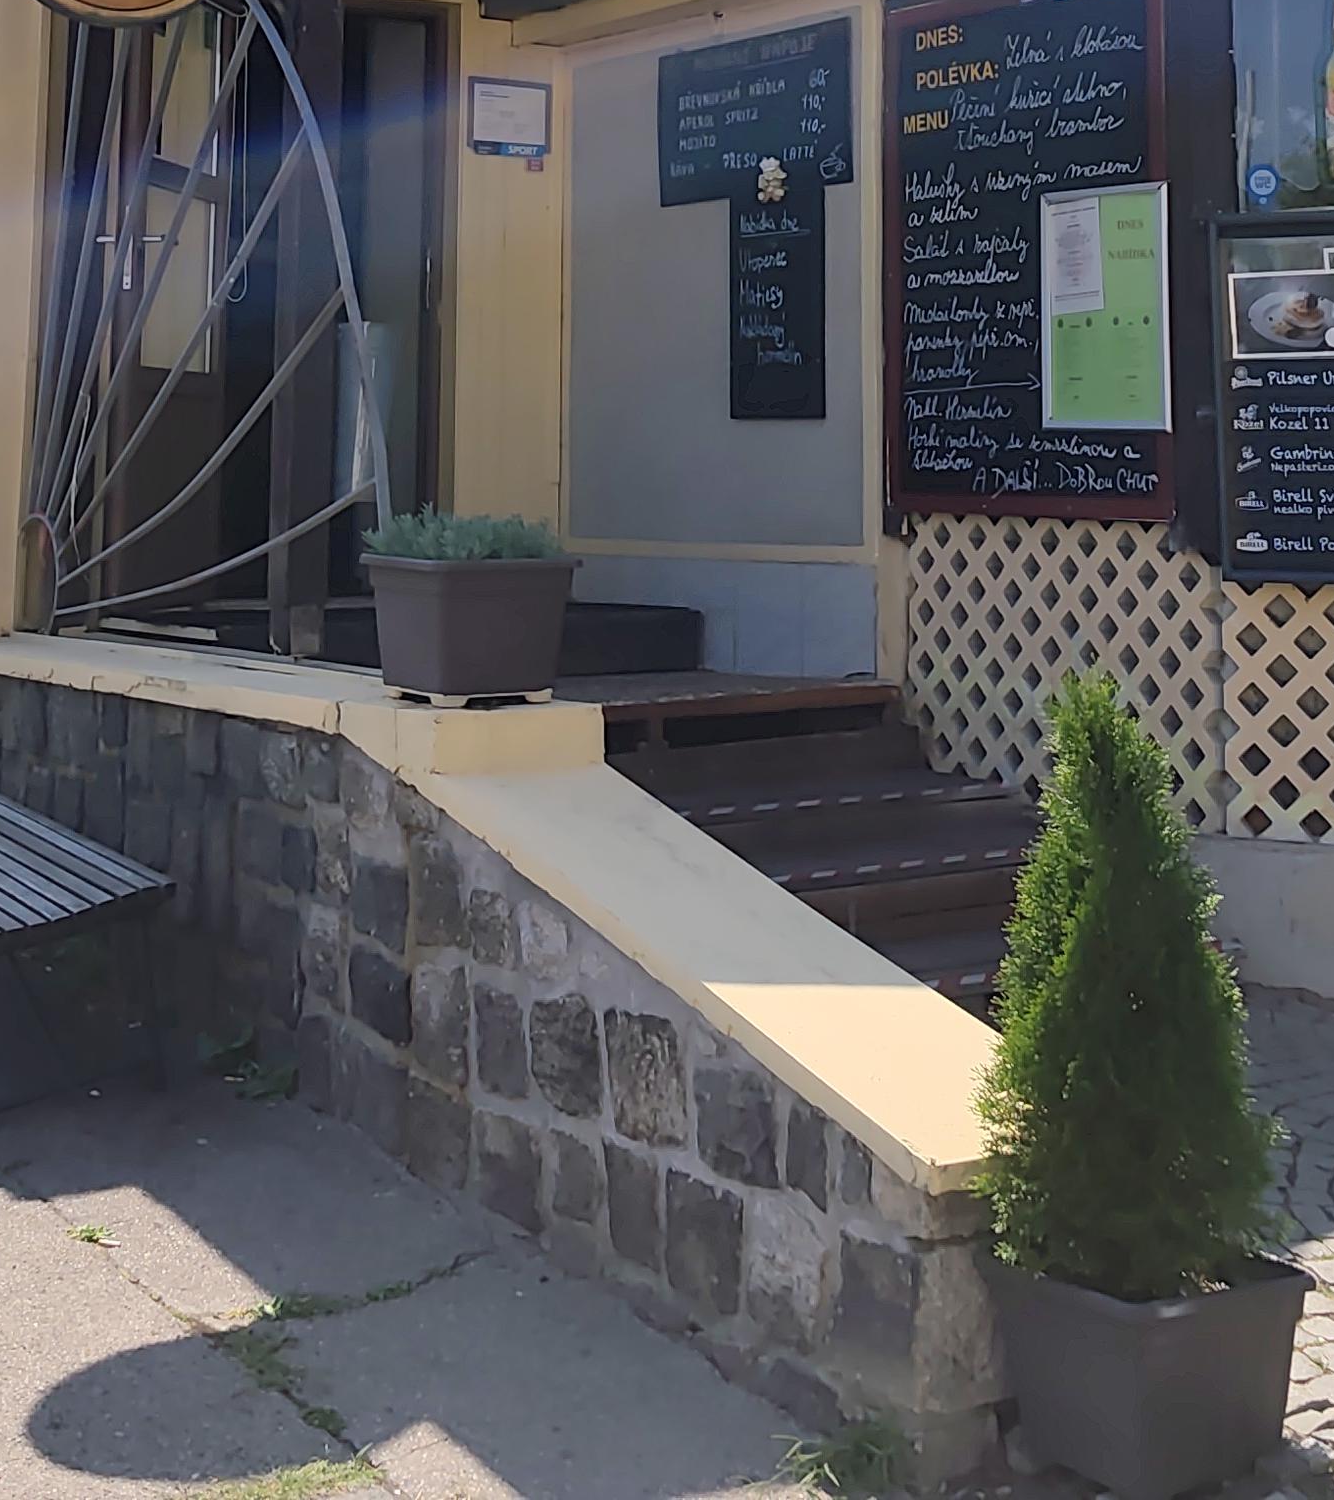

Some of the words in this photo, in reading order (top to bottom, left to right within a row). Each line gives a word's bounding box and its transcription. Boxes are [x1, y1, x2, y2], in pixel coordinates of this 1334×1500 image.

[916, 25, 964, 51] DNES:
[916, 60, 999, 91] POLÉVKA:
[904, 109, 949, 135] MENU
[1267, 370, 1318, 386] Pilsner
[1269, 417, 1309, 431] Kozel
[1314, 417, 1330, 431] 11
[1273, 488, 1314, 503] Birell
[1273, 504, 1313, 515] nealko
[1273, 536, 1314, 551] Birell
